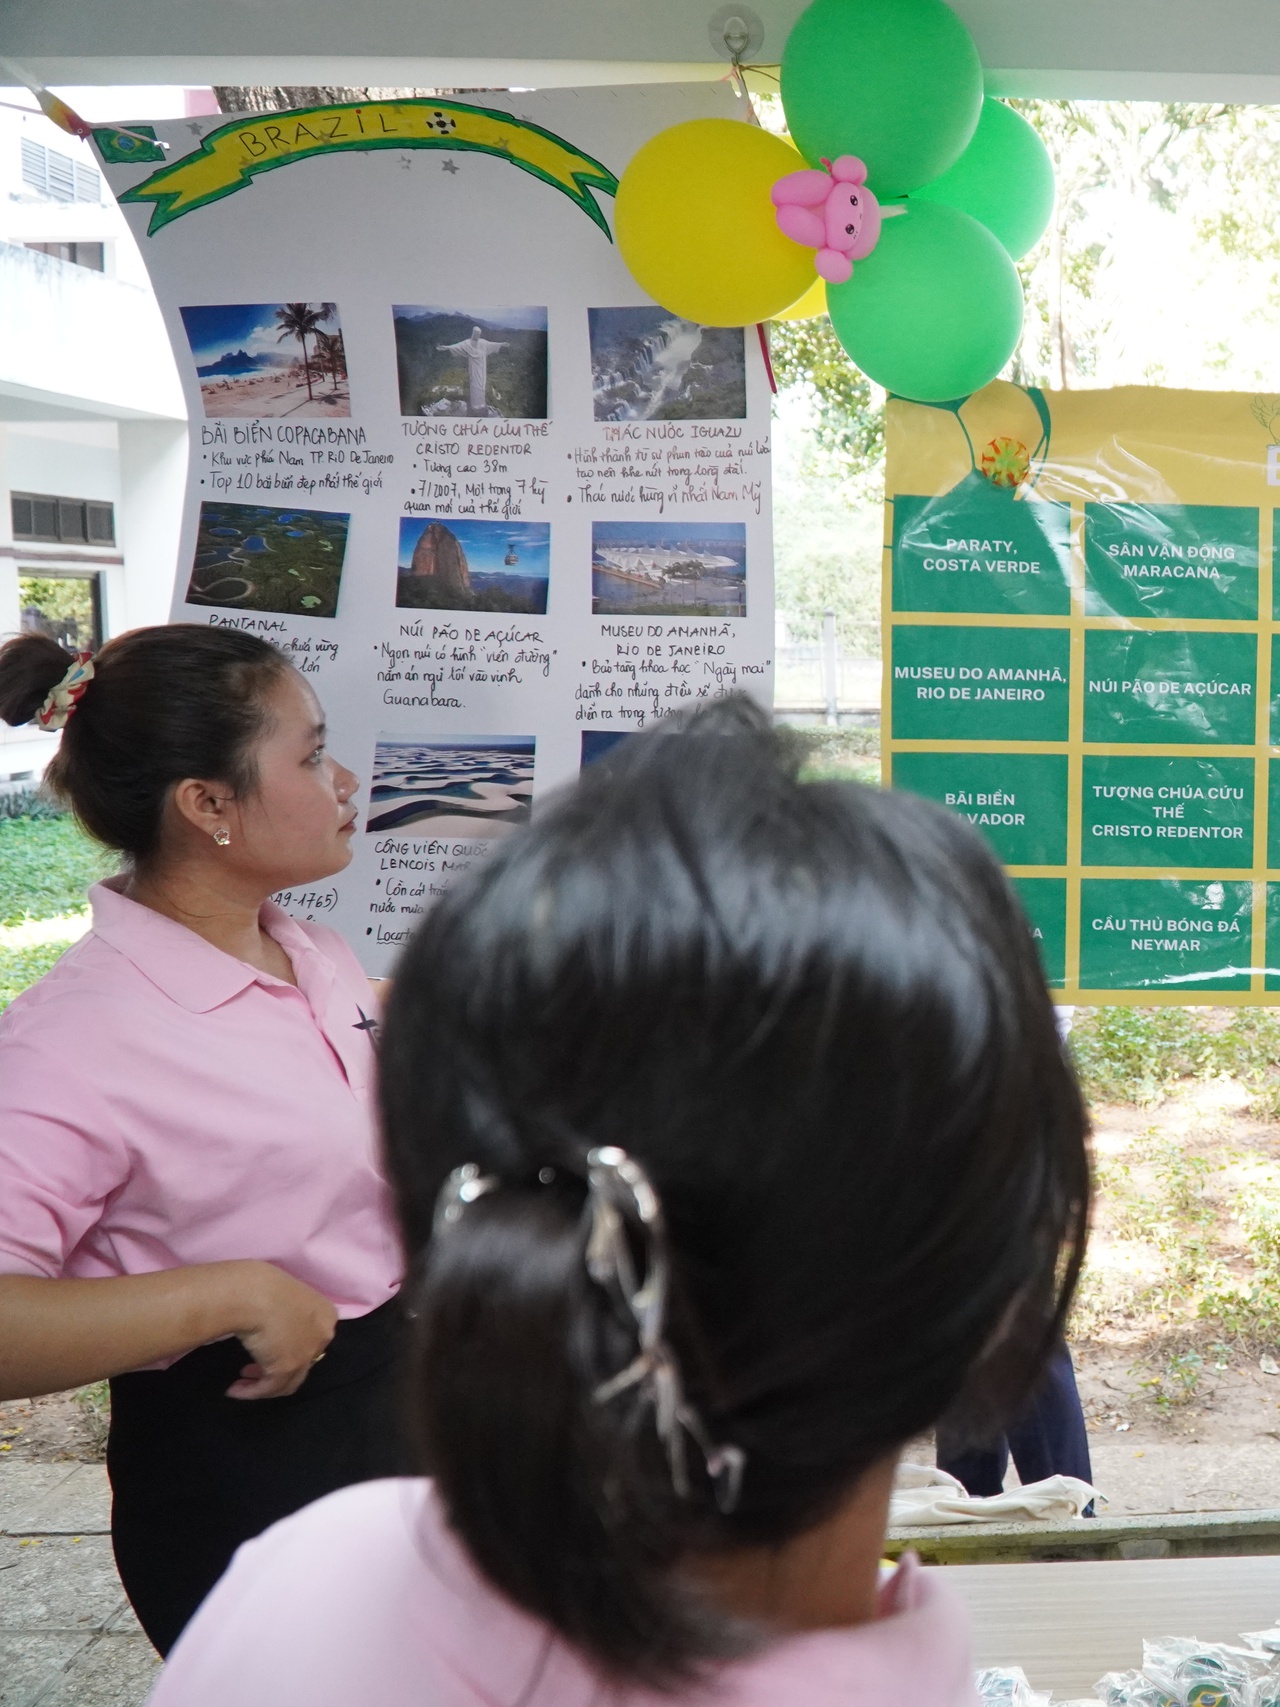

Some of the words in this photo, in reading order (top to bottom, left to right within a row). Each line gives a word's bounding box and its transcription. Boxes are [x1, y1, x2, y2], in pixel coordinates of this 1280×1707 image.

[453, 419, 488, 435] CHÚA
[277, 426, 367, 445] COPACABANA
[468, 444, 532, 455] REDENTOR
[279, 453, 304, 465] Nam
[484, 460, 507, 472] 38m
[210, 471, 232, 493] Top
[236, 473, 252, 489] 10
[516, 479, 525, 493] 7
[712, 486, 737, 501] Nam
[404, 501, 430, 515] quan
[947, 539, 1017, 555] PARATY,
[1109, 542, 1143, 556] SÂN
[1148, 543, 1183, 560] VẬN
[1187, 544, 1235, 561] ĐỘNG
[923, 559, 982, 572] COSTA
[985, 560, 1040, 574] VERDE
[1123, 565, 1220, 579] MARACANA
[209, 615, 287, 631] PANTANAL
[466, 629, 480, 641] DE
[602, 625, 643, 637] MUSEU
[648, 626, 662, 636] DO
[895, 666, 956, 680] MUSEU
[960, 668, 983, 680] DO
[987, 667, 1066, 684] AMANHÃ,
[605, 684, 622, 697] cho
[917, 687, 950, 700] RIO
[953, 688, 971, 700] DE
[974, 689, 1045, 701] JANEIRO
[1089, 678, 1117, 693] NÚI
[1122, 679, 1155, 693] PÃO
[1159, 682, 1179, 693] DE
[1184, 680, 1251, 697] AÇÚCAR
[383, 689, 465, 707] Guanabara.
[945, 791, 972, 804] BÃI
[977, 789, 1015, 805] BIỂN
[1093, 786, 1154, 800] TƯỢNG
[1157, 784, 1204, 799] CHÚA
[1208, 785, 1244, 800] CỨU
[1153, 803, 1185, 818] THẾ
[958, 812, 1025, 825] VADOR
[1092, 824, 1153, 837] CRISTO
[1157, 826, 1243, 839] REDENTOR
[375, 839, 408, 854] CÔNG
[1092, 915, 1126, 930] CẦU
[1129, 916, 1163, 931] THỦ
[1167, 918, 1213, 932] BÓNG
[1218, 918, 1240, 932] ĐÁ
[1131, 939, 1200, 951] NEYMAR
